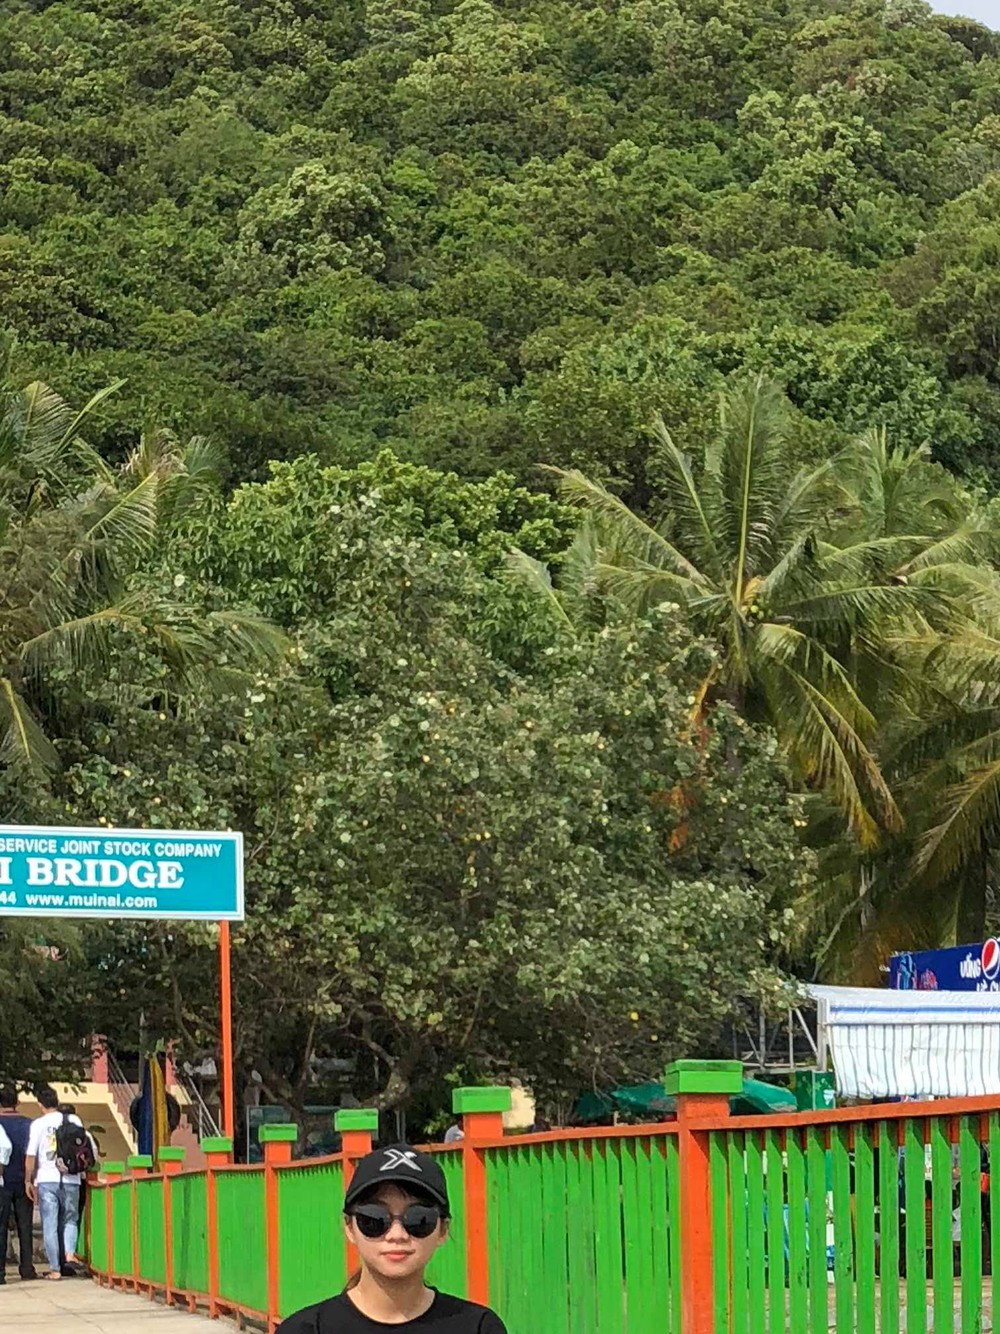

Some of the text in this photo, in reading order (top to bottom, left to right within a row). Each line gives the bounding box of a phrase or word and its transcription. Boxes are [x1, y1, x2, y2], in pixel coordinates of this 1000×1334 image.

[0, 838, 222, 858] SERVICE JOINT STOCK COMPANY
[26, 857, 184, 889] BRIDGE
[26, 893, 158, 908] www.muinai.com
